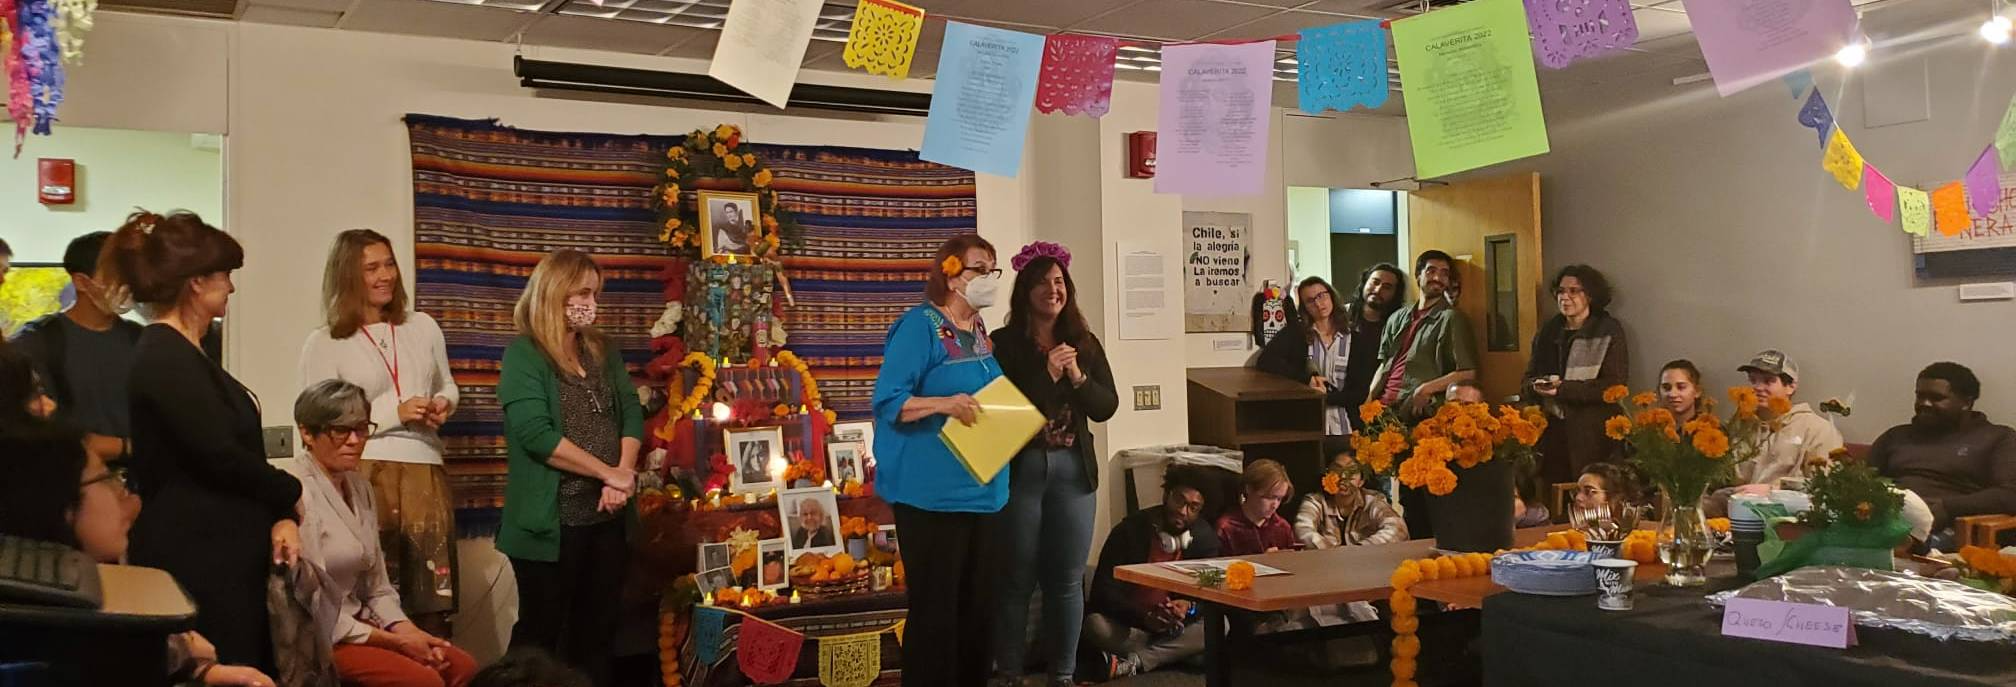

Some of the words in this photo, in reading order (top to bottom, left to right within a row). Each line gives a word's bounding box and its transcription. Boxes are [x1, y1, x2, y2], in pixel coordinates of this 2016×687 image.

[1425, 34, 1472, 53] CALAVERITA
[1473, 29, 1492, 41] 2022
[1192, 227, 1226, 240] Chile,
[1193, 241, 1202, 251] la
[1196, 255, 1210, 265] NO
[1213, 256, 1240, 265] viene
[1193, 266, 1205, 276] La
[1207, 267, 1240, 276] iremos
[1195, 279, 1201, 287] a
[1206, 277, 1241, 287] buscar
[1596, 568, 1621, 582] Mix
